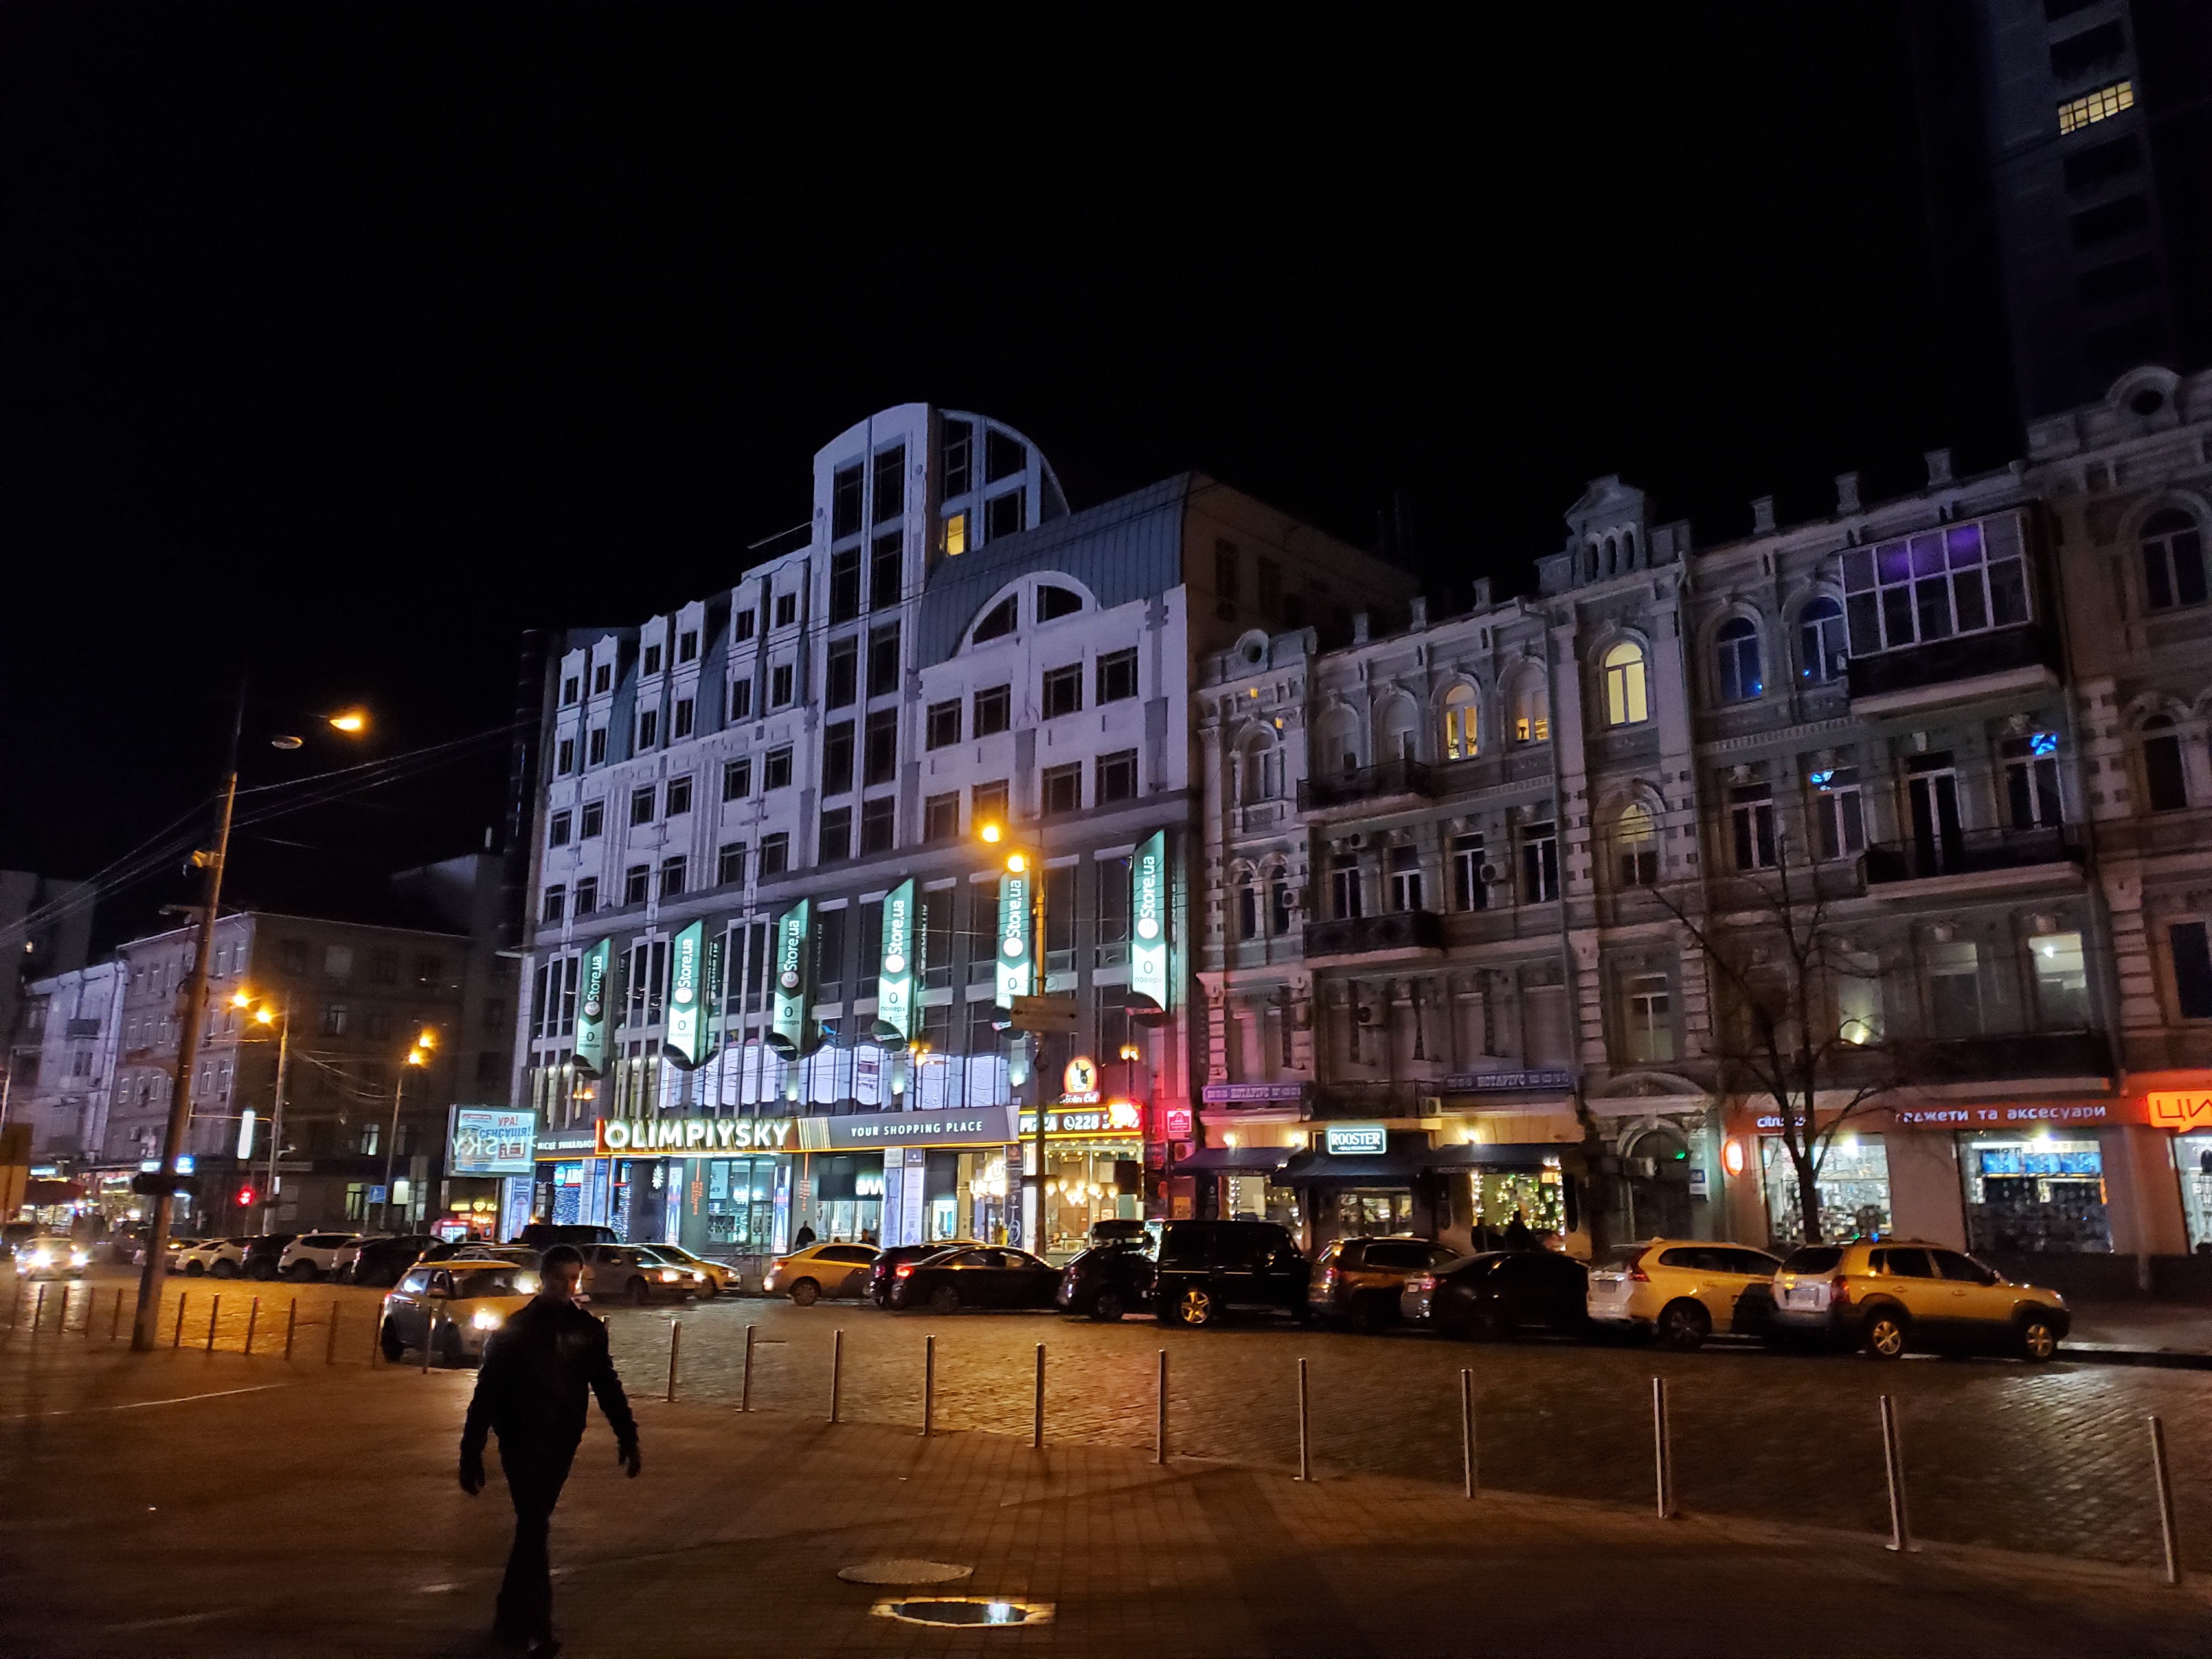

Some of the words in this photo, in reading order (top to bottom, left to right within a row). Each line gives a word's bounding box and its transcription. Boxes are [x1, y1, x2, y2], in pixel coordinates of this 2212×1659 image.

[498, 1115, 518, 1126] УРА!
[1978, 1109, 1998, 1120] та
[2007, 1105, 2106, 1121] аксесуари
[851, 1126, 879, 1137] YOUR
[884, 1124, 941, 1135] SHOPPING
[946, 1121, 982, 1132] PLACE
[1075, 1114, 1099, 1130] 228
[604, 1124, 790, 1148] OLIMPIYSKY
[1331, 1132, 1381, 1146] ROOSTER
